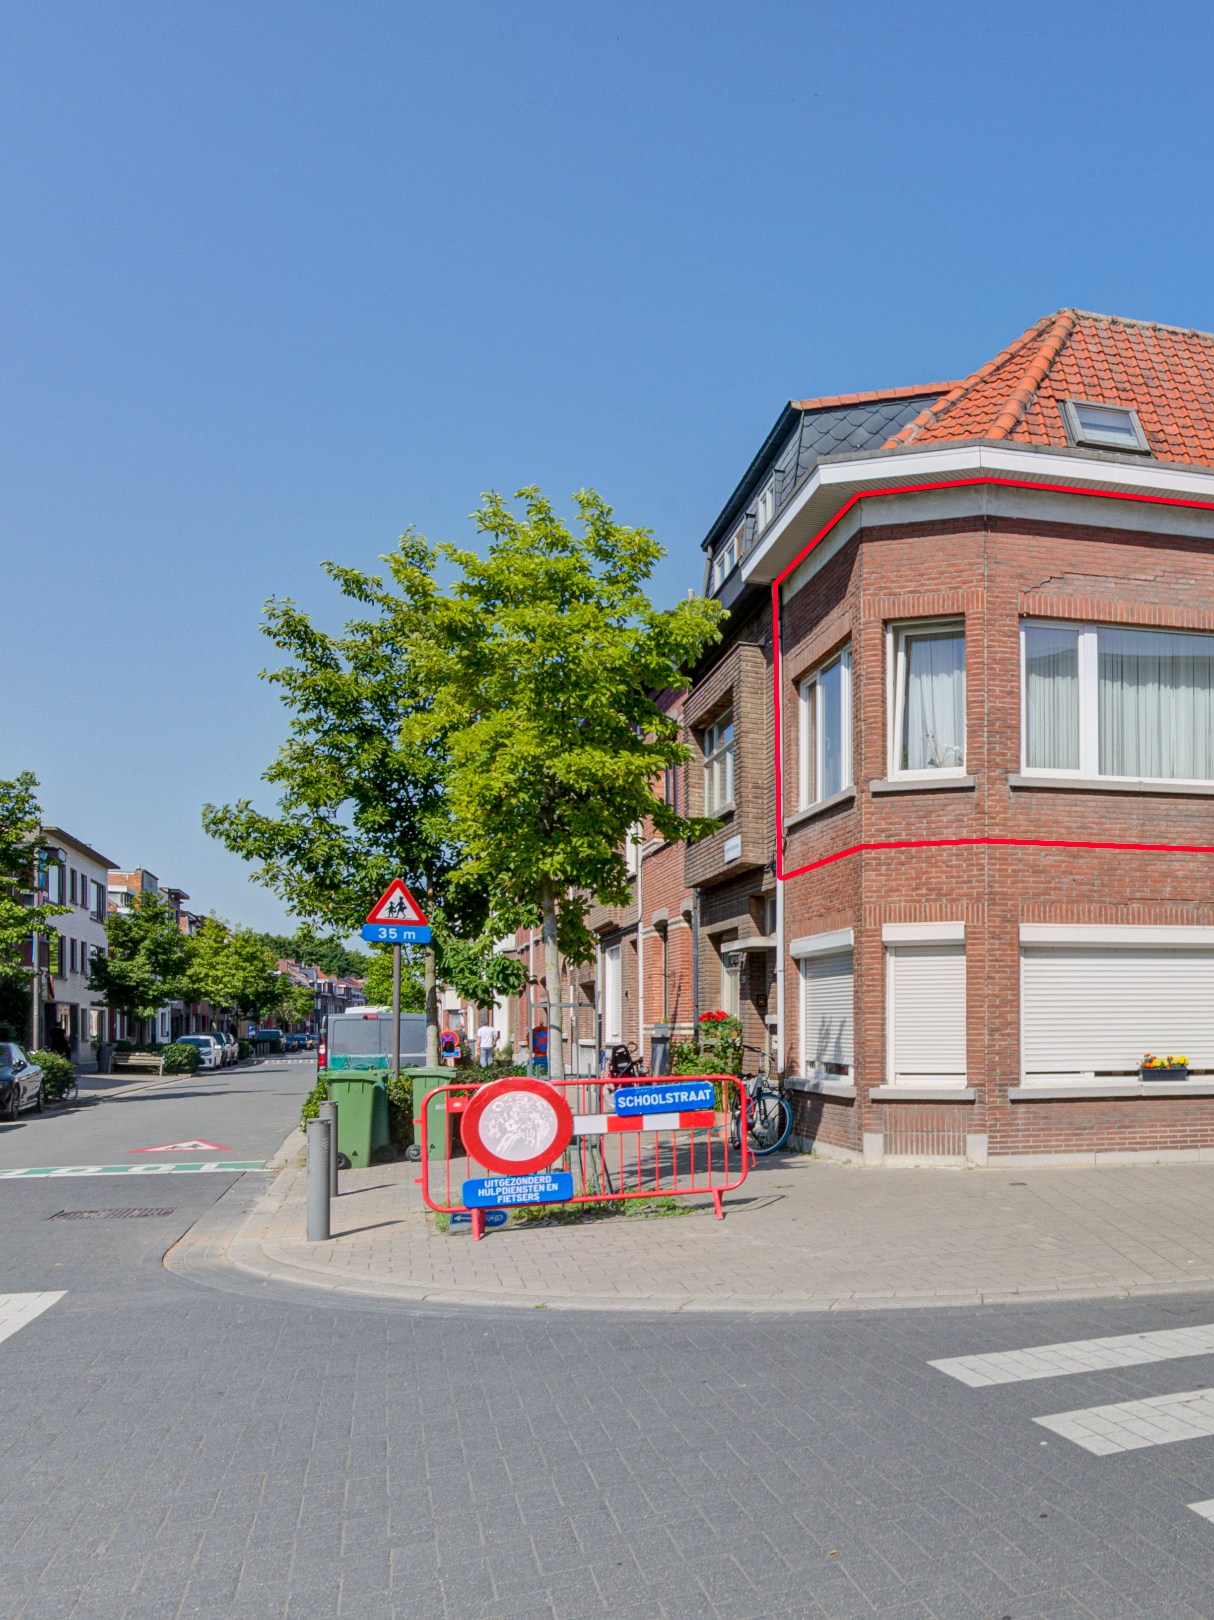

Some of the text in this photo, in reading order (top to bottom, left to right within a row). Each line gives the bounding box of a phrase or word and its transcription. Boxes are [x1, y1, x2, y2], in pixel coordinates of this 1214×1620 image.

[378, 928, 416, 940] 35 m
[617, 1089, 712, 1108] SCHOOLSTRAAT
[484, 1175, 552, 1188] UITGEZONDERD
[478, 1183, 559, 1197] HULPDIENSTEN EN
[497, 1192, 540, 1203] FIETSERS
